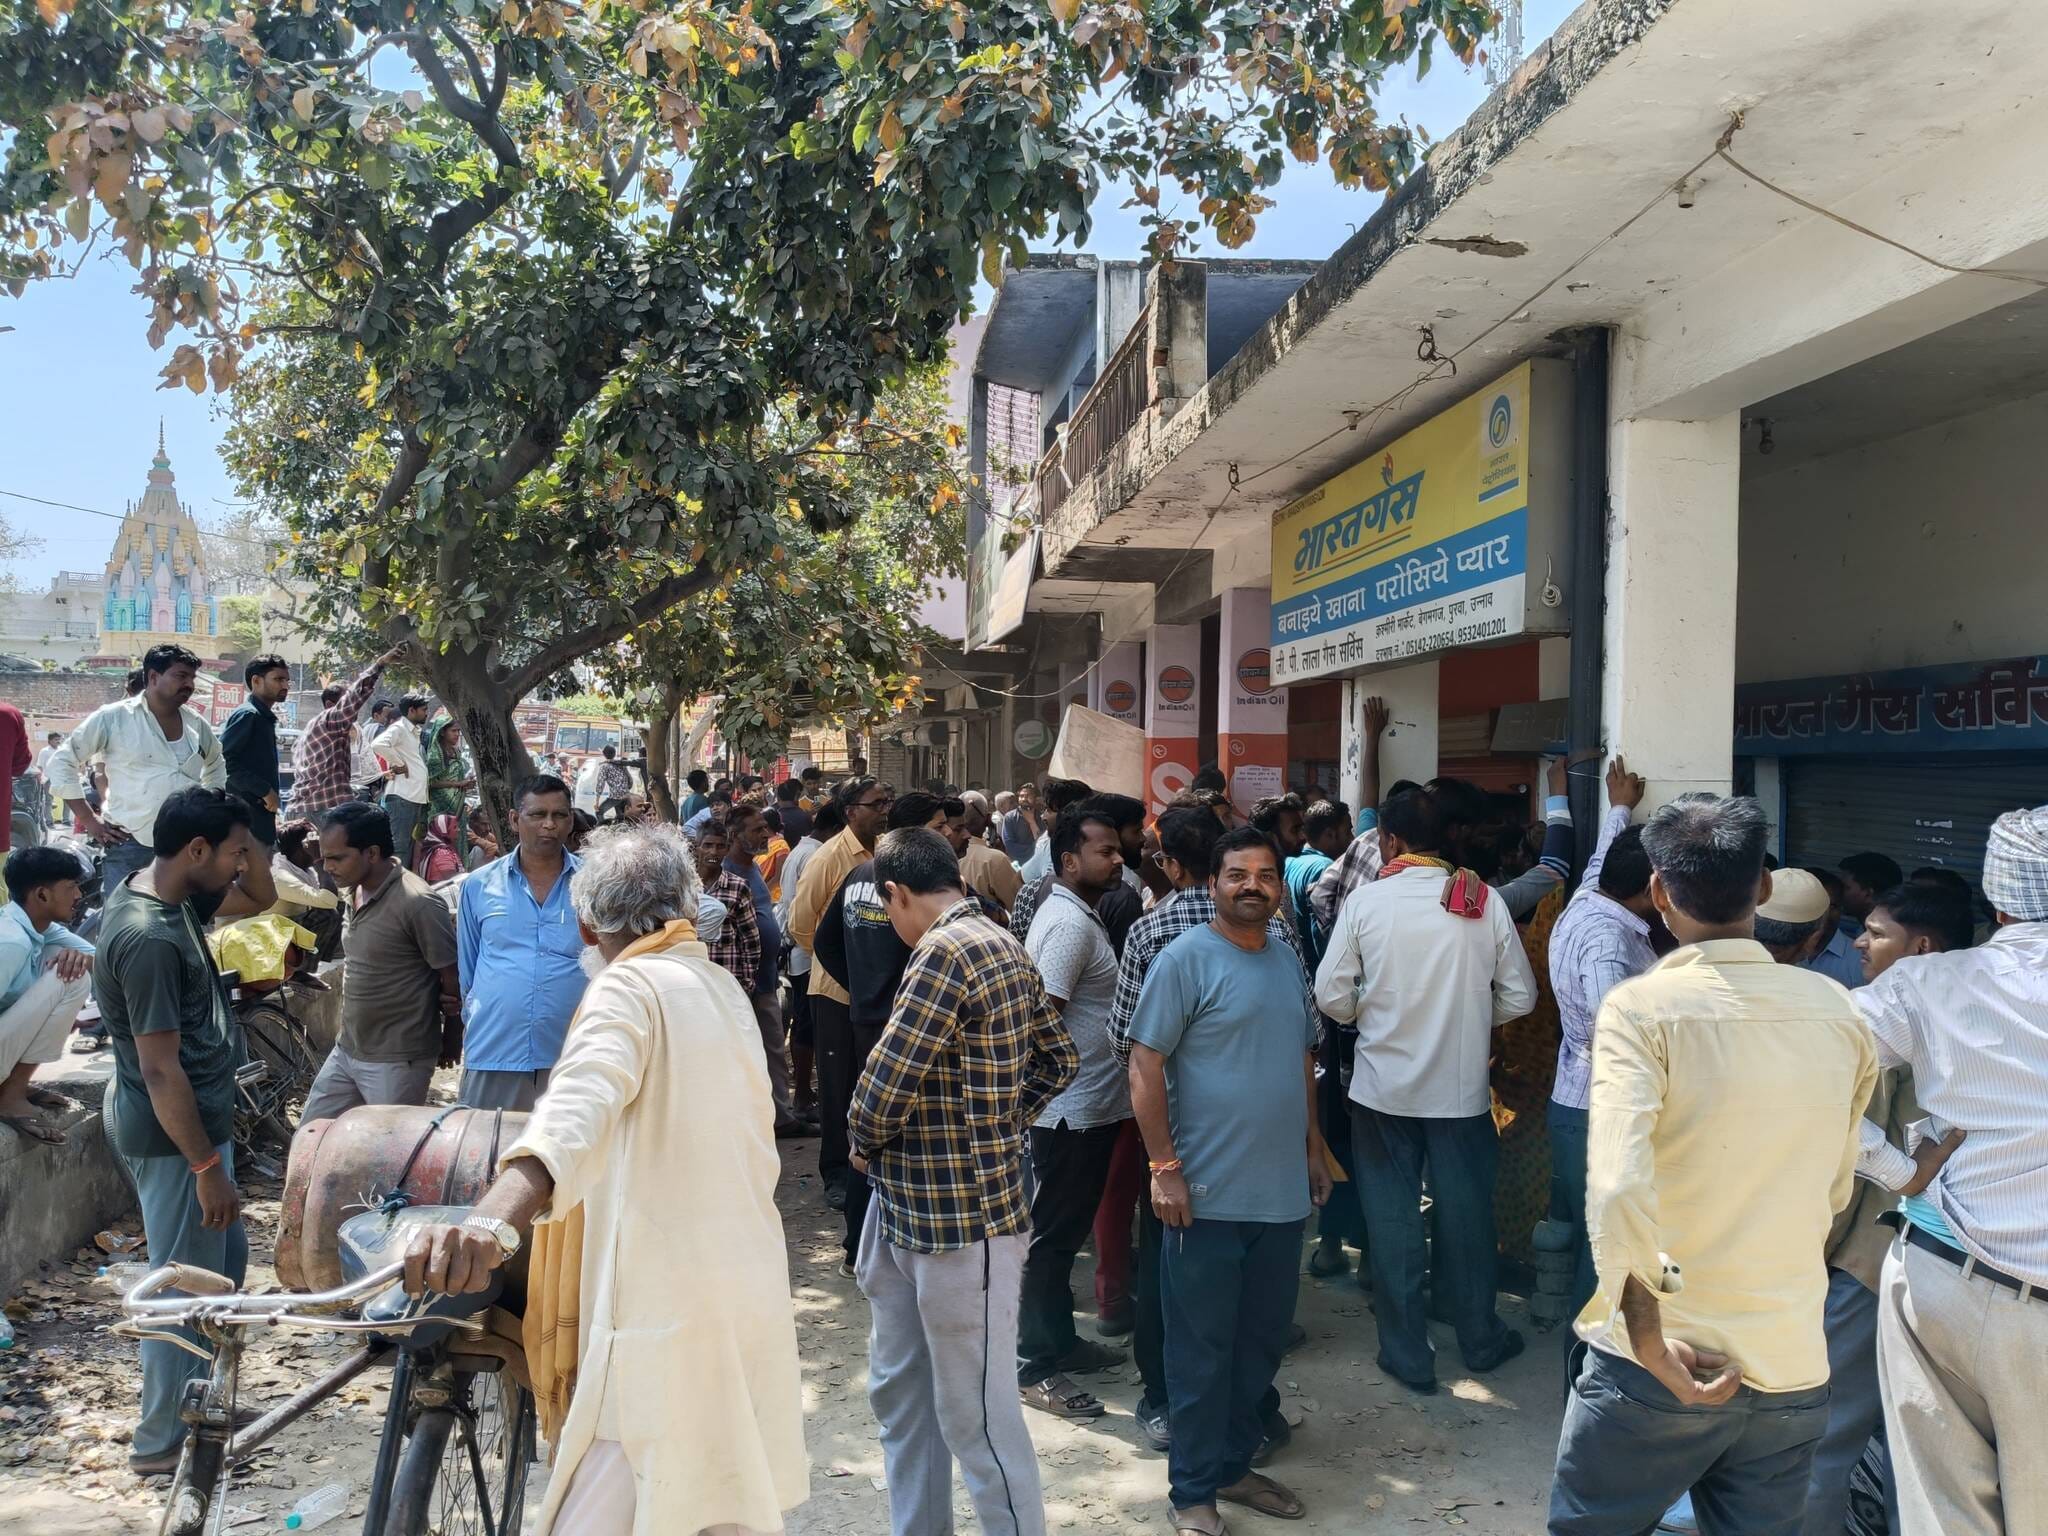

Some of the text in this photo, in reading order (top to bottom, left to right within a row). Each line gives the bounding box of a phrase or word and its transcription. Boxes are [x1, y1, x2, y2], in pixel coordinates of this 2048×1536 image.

[1277, 534, 1511, 634] बनाइये खाना परोसिये प्यार
[1458, 616, 1507, 644] 9532401201
[1301, 649, 1320, 672] लाला
